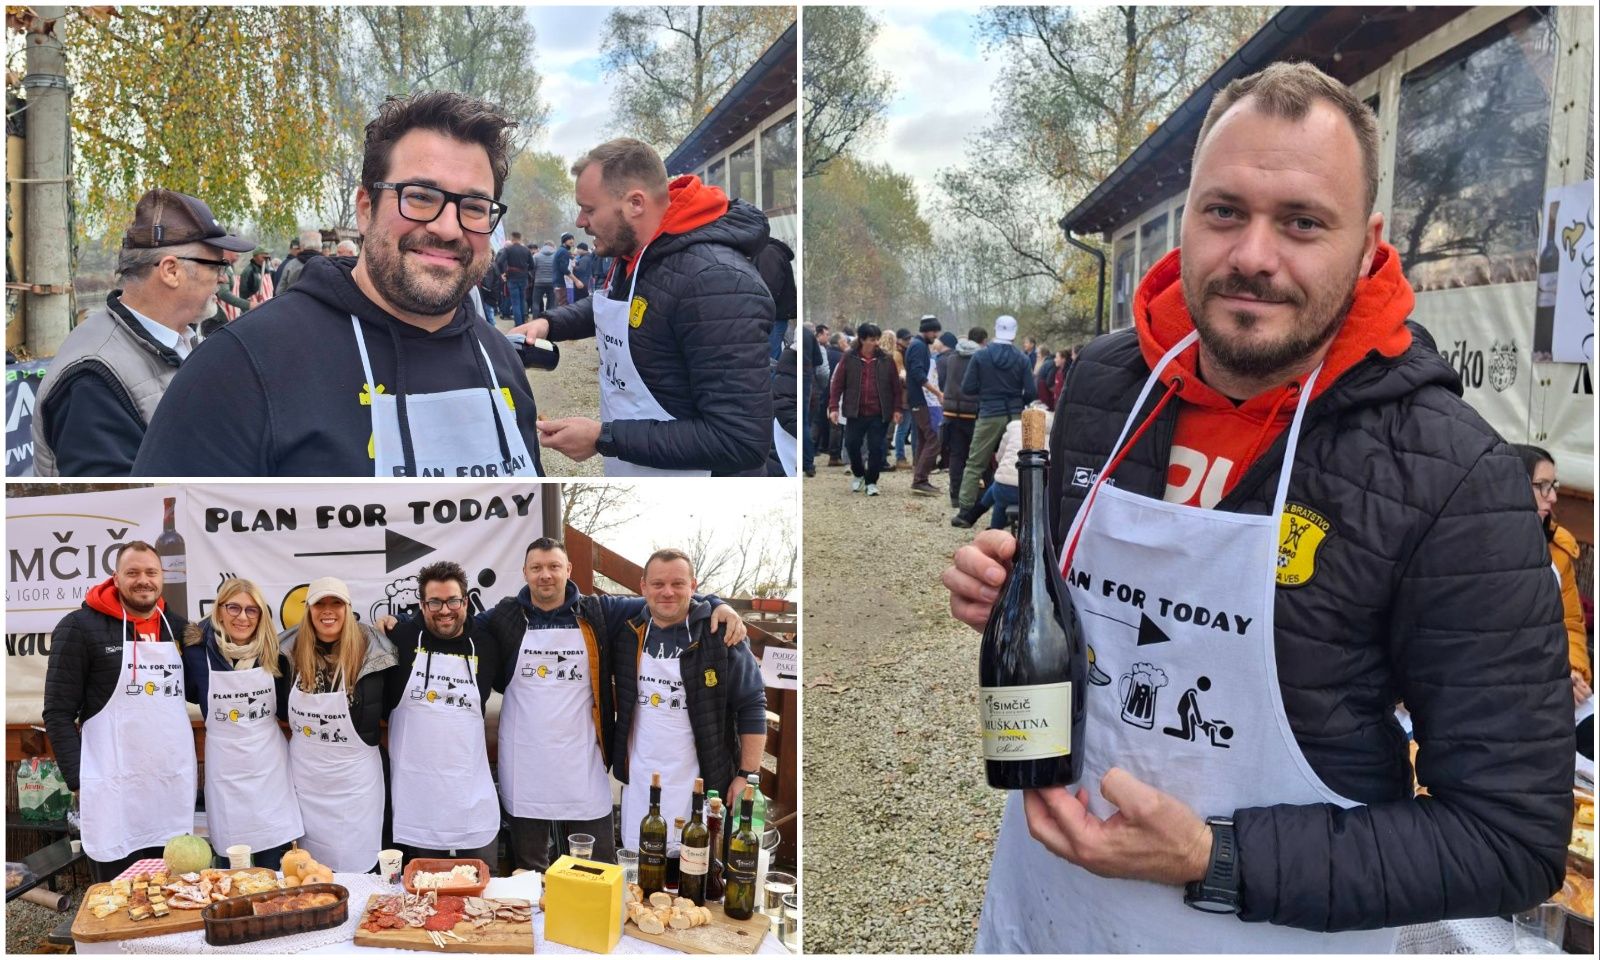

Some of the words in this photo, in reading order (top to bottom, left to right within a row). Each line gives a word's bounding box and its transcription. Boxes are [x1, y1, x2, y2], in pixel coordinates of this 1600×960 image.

[456, 462, 498, 477] FOR
[204, 507, 297, 533] PLAN
[315, 503, 387, 529] FOR
[407, 492, 535, 525] TODAY
[1290, 504, 1330, 531] BRATSTVO
[1284, 574, 1300, 583] VES
[18, 588, 50, 602] IGOR
[57, 587, 66, 600] &
[1102, 579, 1147, 609] FOR
[1158, 597, 1253, 635] TODAY
[639, 675, 656, 683] PLAN
[252, 688, 272, 697] TODAY
[993, 699, 1031, 711] SIMČIČ
[291, 706, 305, 718] PLAN
[985, 718, 1049, 730] MUŠKATNA
